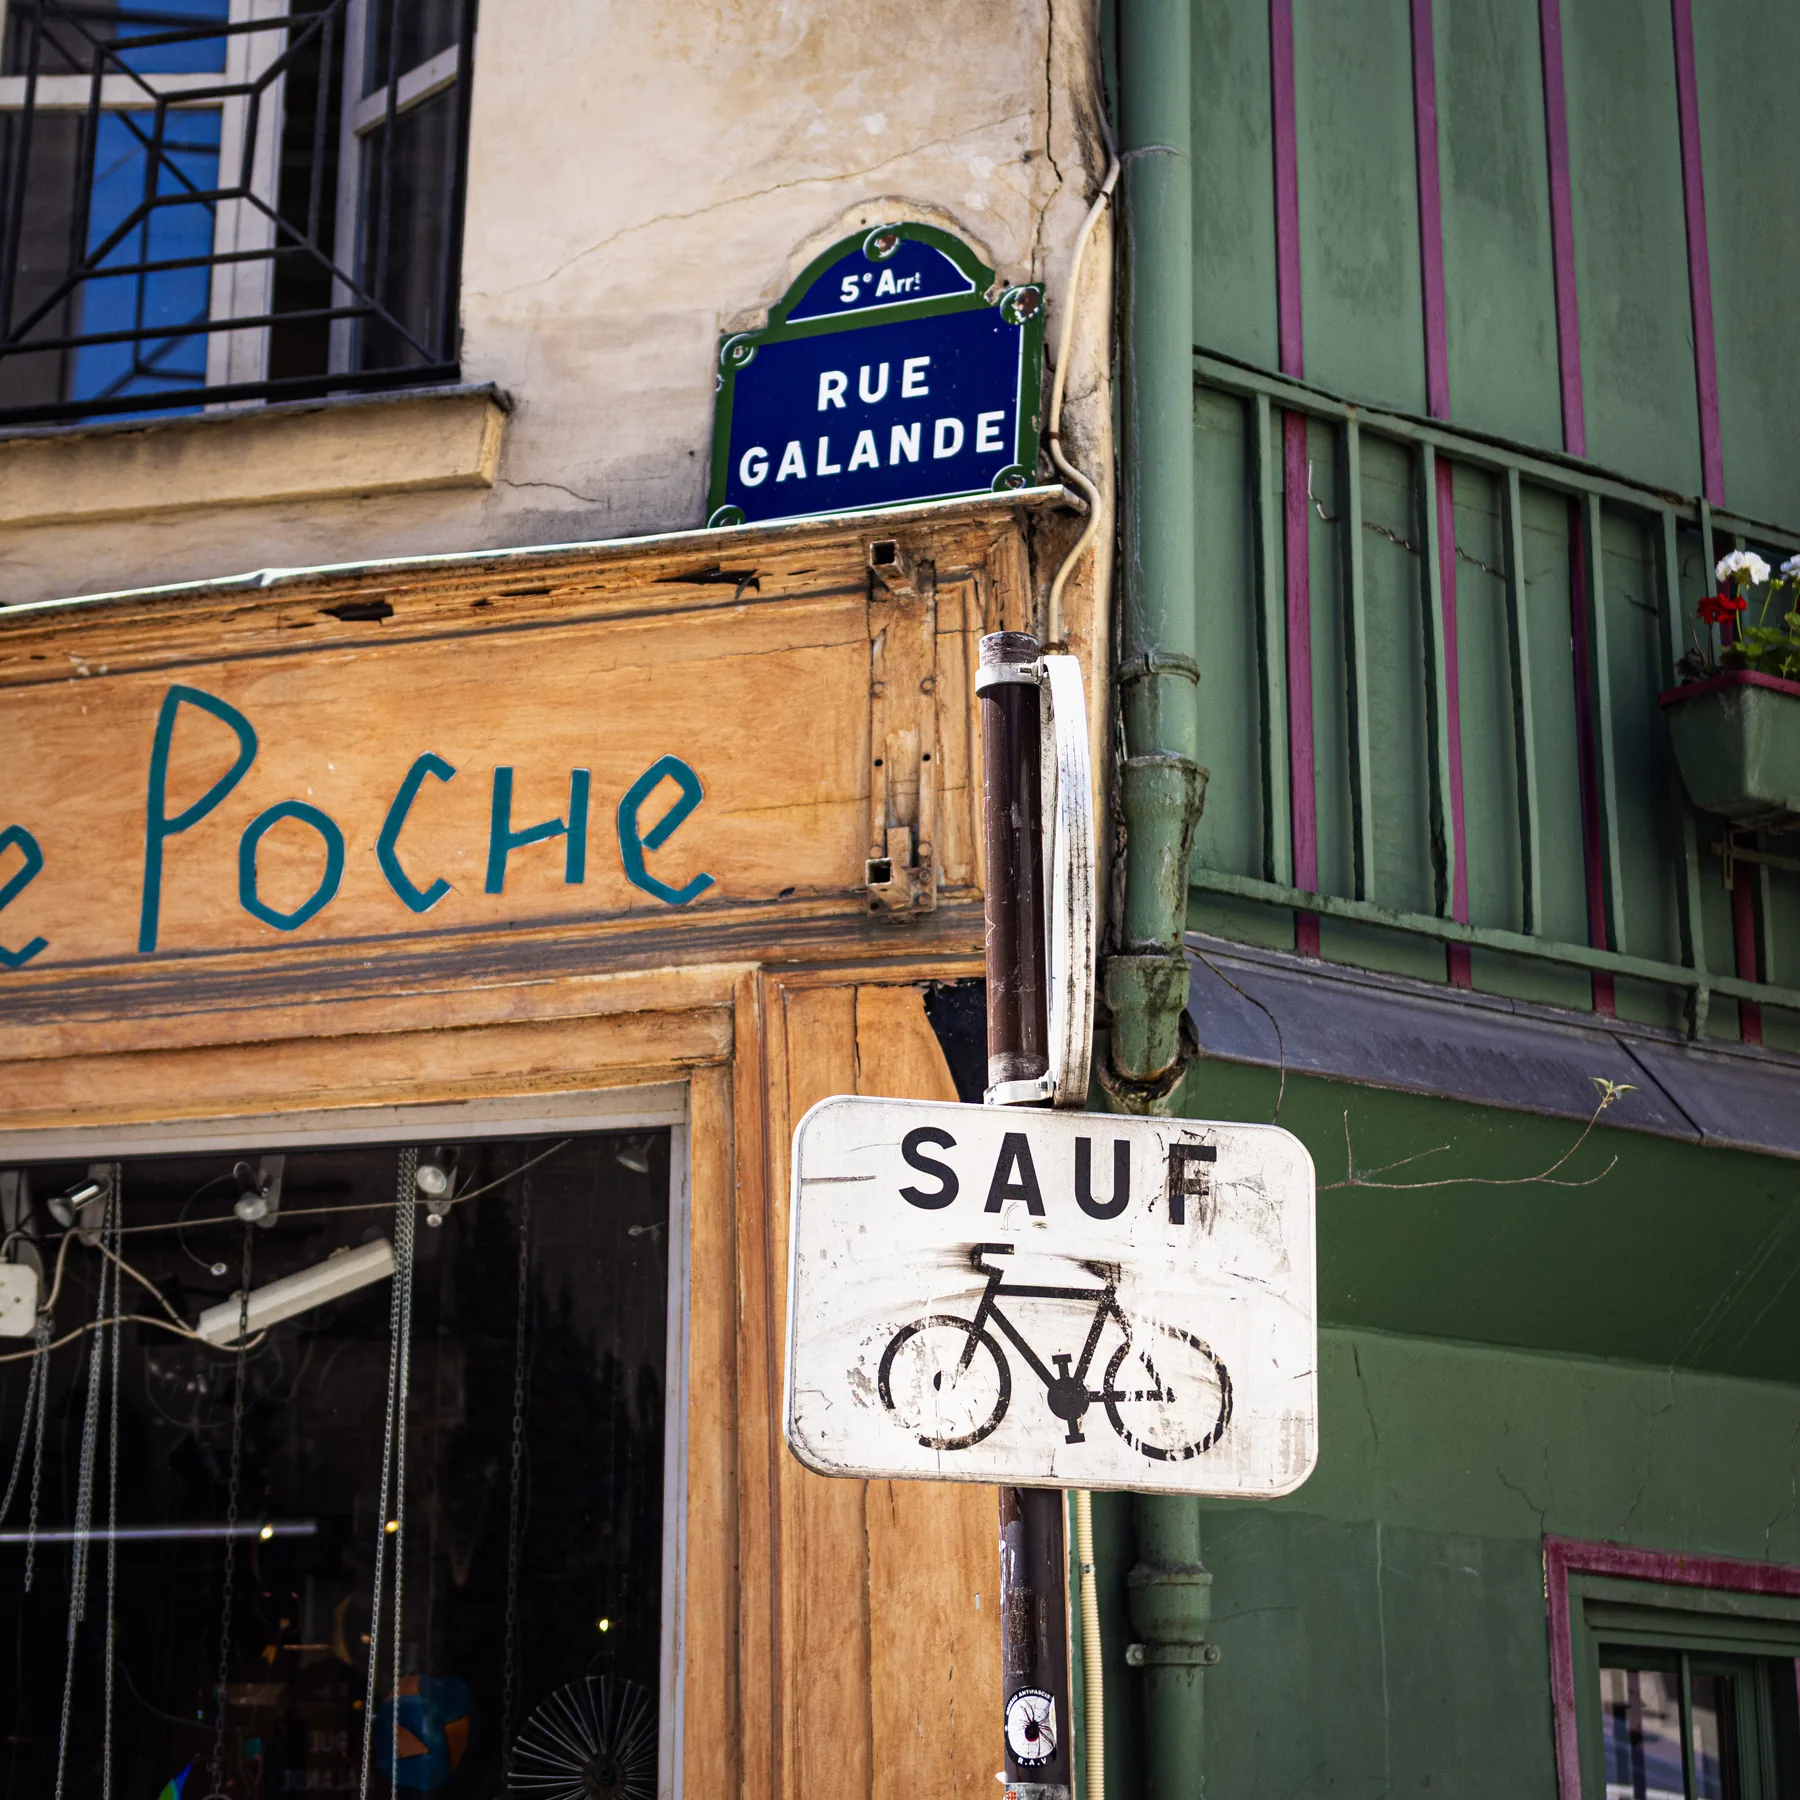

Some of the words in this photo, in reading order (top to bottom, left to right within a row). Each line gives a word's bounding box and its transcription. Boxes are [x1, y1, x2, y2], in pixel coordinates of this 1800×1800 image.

[818, 356, 931, 411] RUE
[739, 410, 1005, 487] GALANDE
[898, 1126, 1217, 1225] SAUF
[1018, 1689, 1051, 1700] ANTIFASCIS
